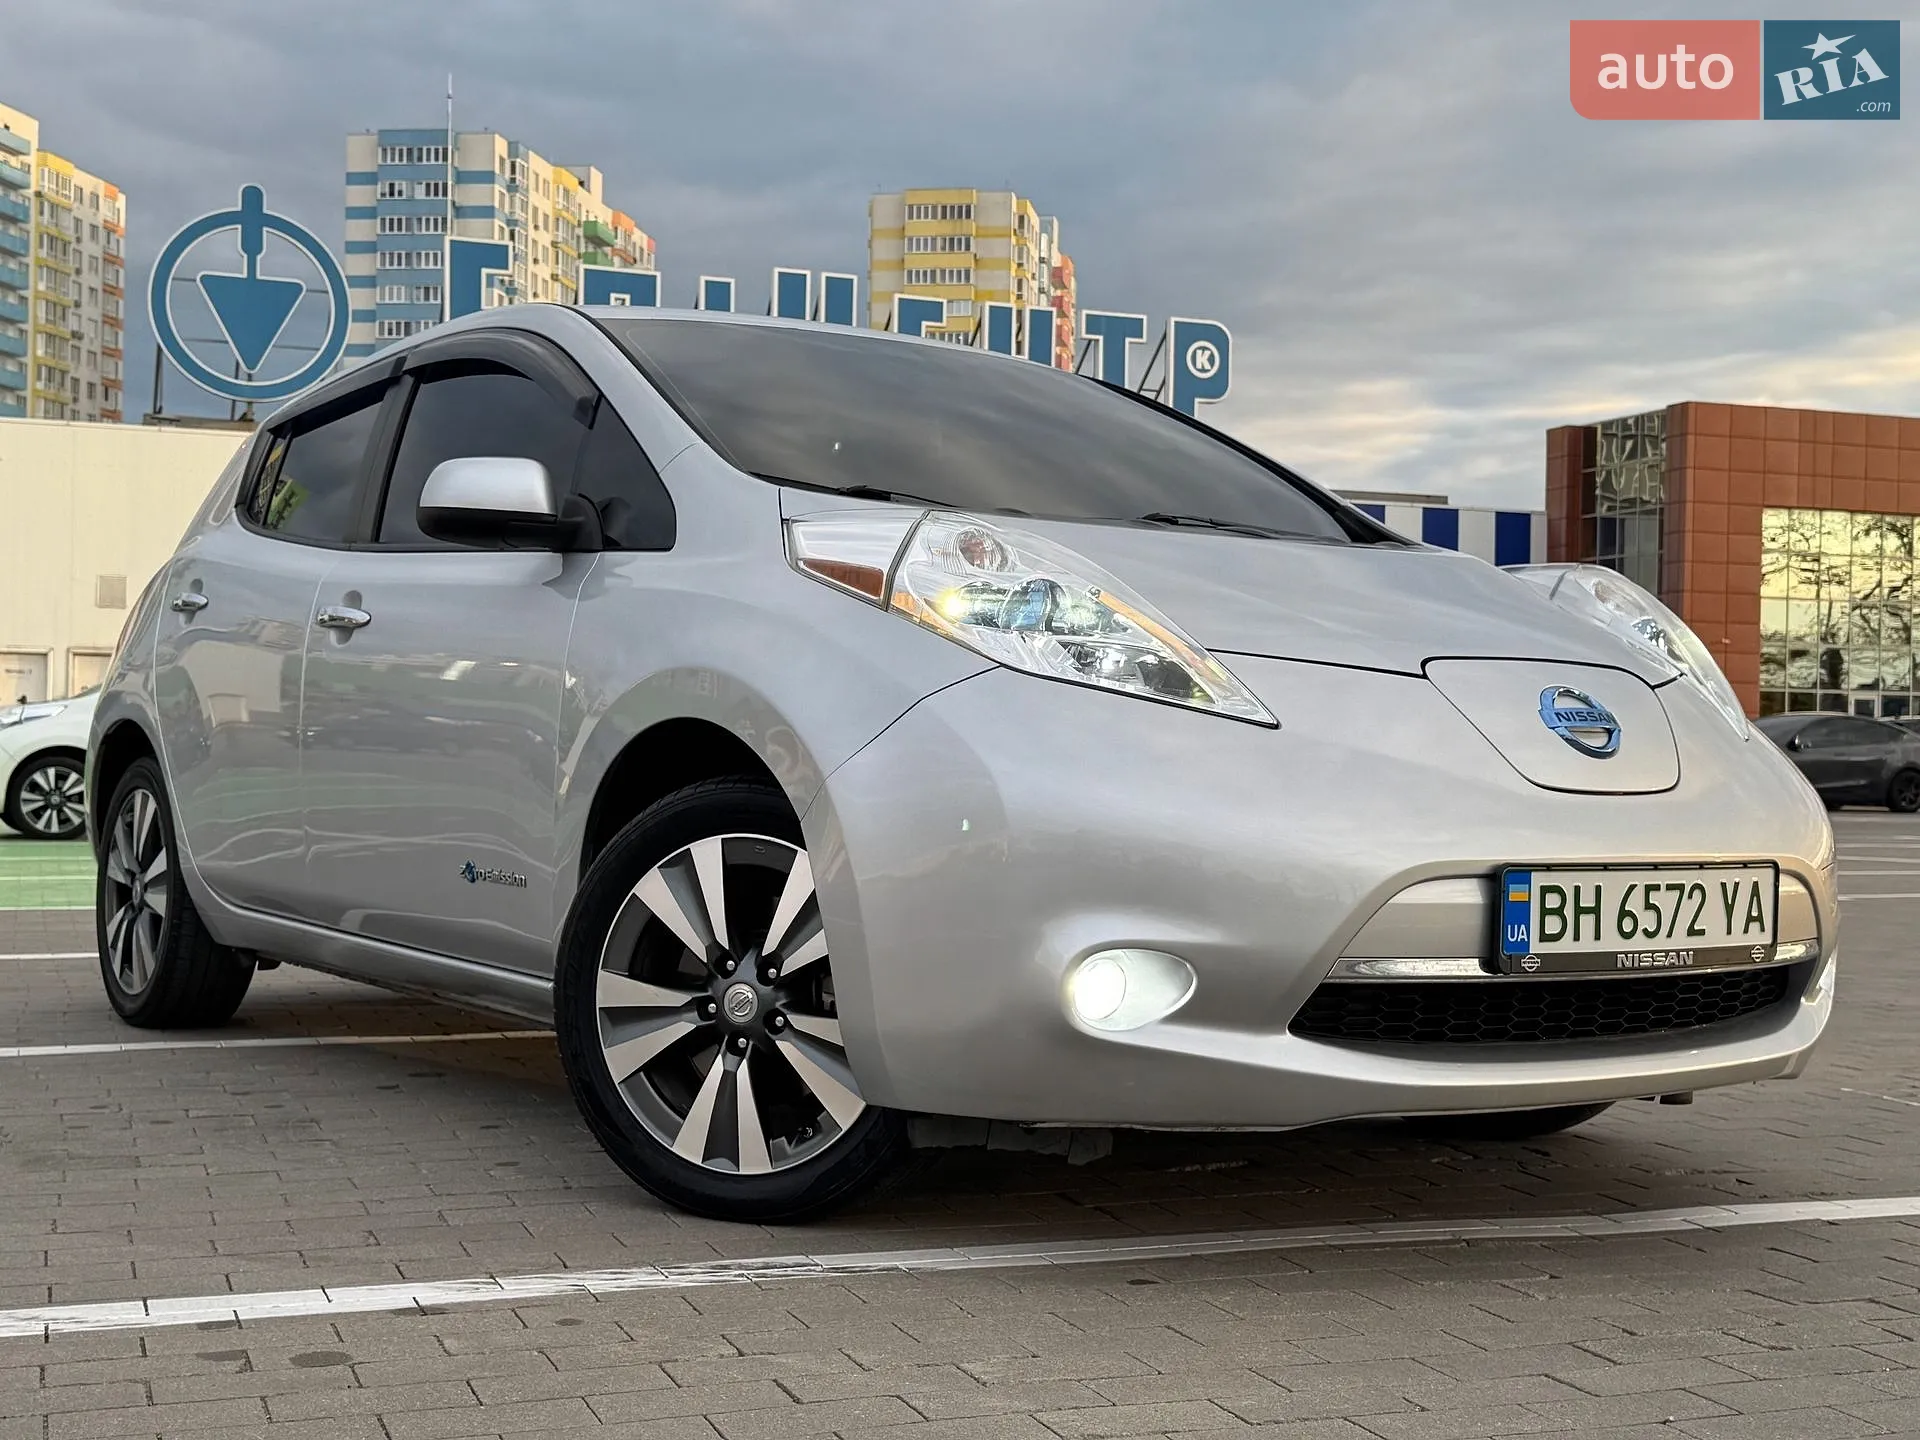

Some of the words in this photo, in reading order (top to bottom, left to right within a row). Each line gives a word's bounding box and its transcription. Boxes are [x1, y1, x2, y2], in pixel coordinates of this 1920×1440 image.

[1554, 710, 1615, 724] NISSAN
[1538, 883, 1602, 943] BH
[1616, 882, 1706, 941] 6572
[1720, 879, 1766, 936] YA
[1507, 924, 1528, 943] UA
[1616, 950, 1694, 969] NISSAN
